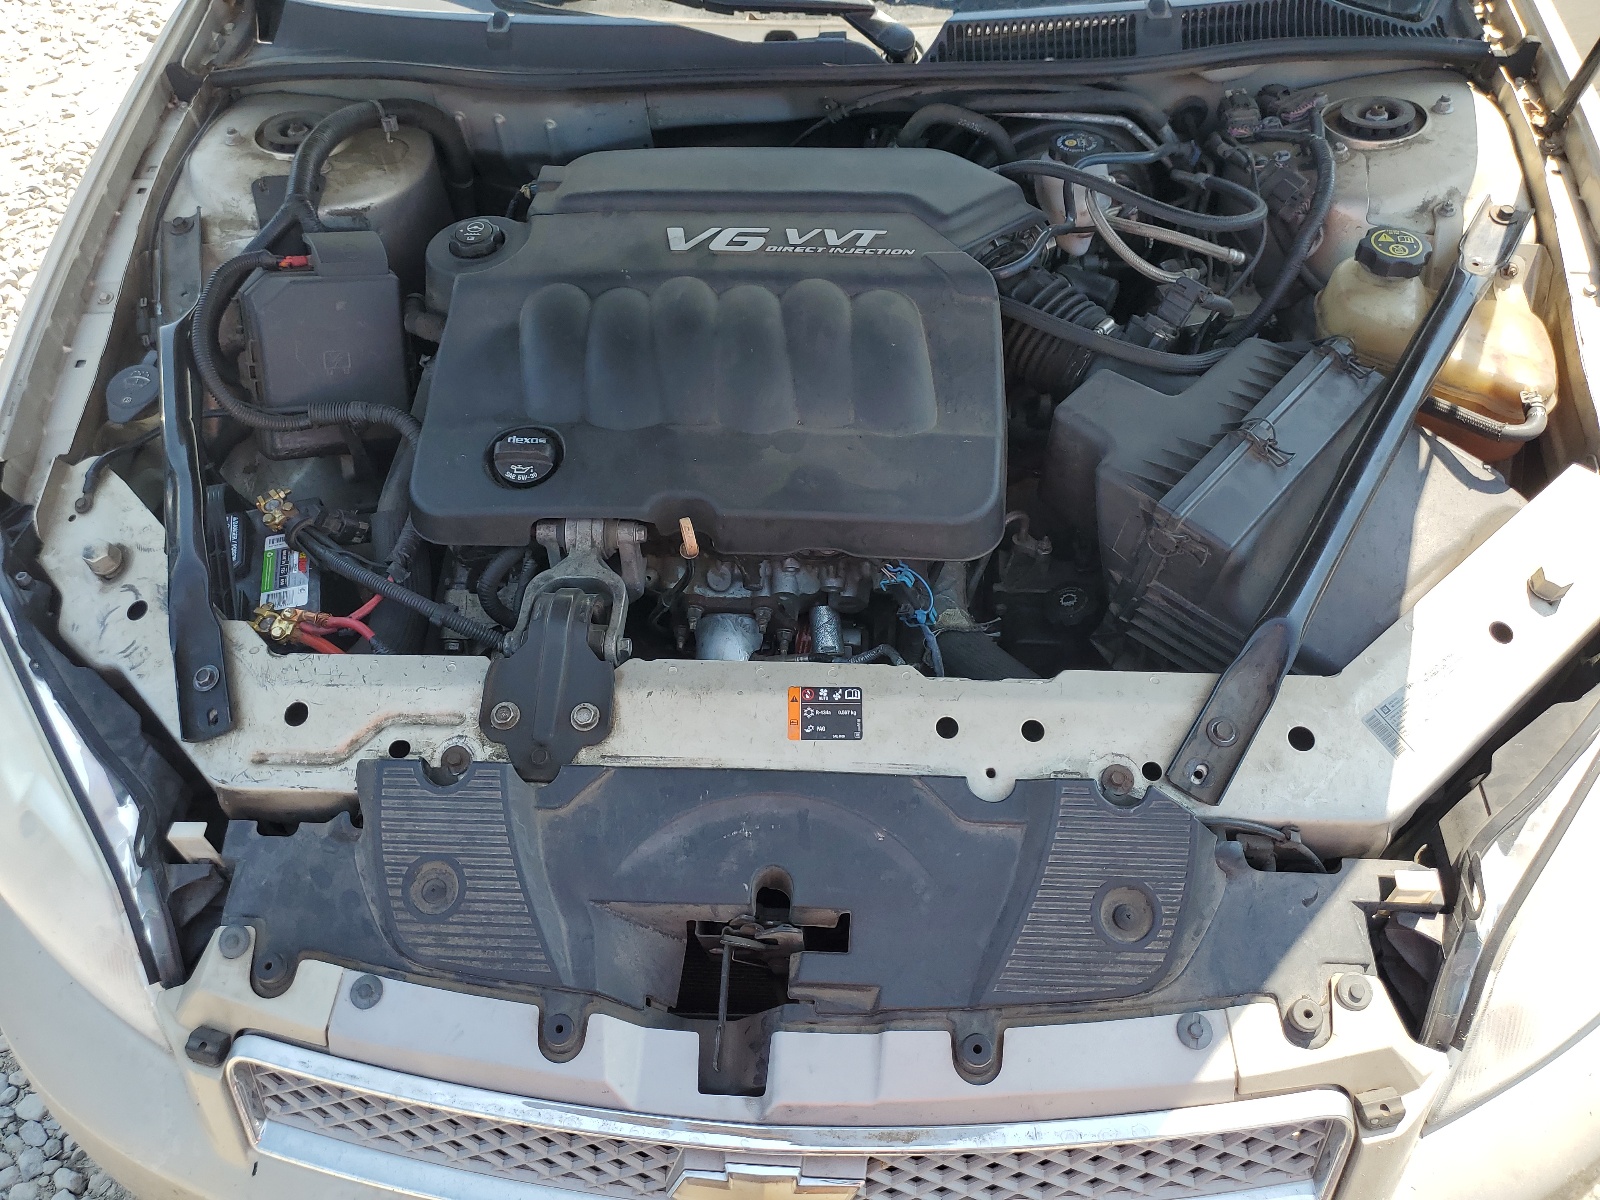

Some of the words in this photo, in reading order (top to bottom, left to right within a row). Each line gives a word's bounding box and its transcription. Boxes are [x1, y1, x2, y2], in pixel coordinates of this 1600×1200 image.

[666, 227, 770, 251] V6
[785, 228, 888, 247] VVT
[764, 245, 827, 254] DIRECT
[828, 246, 916, 255] INJECTION
[507, 435, 547, 444] dexos
[504, 471, 517, 480] SAE
